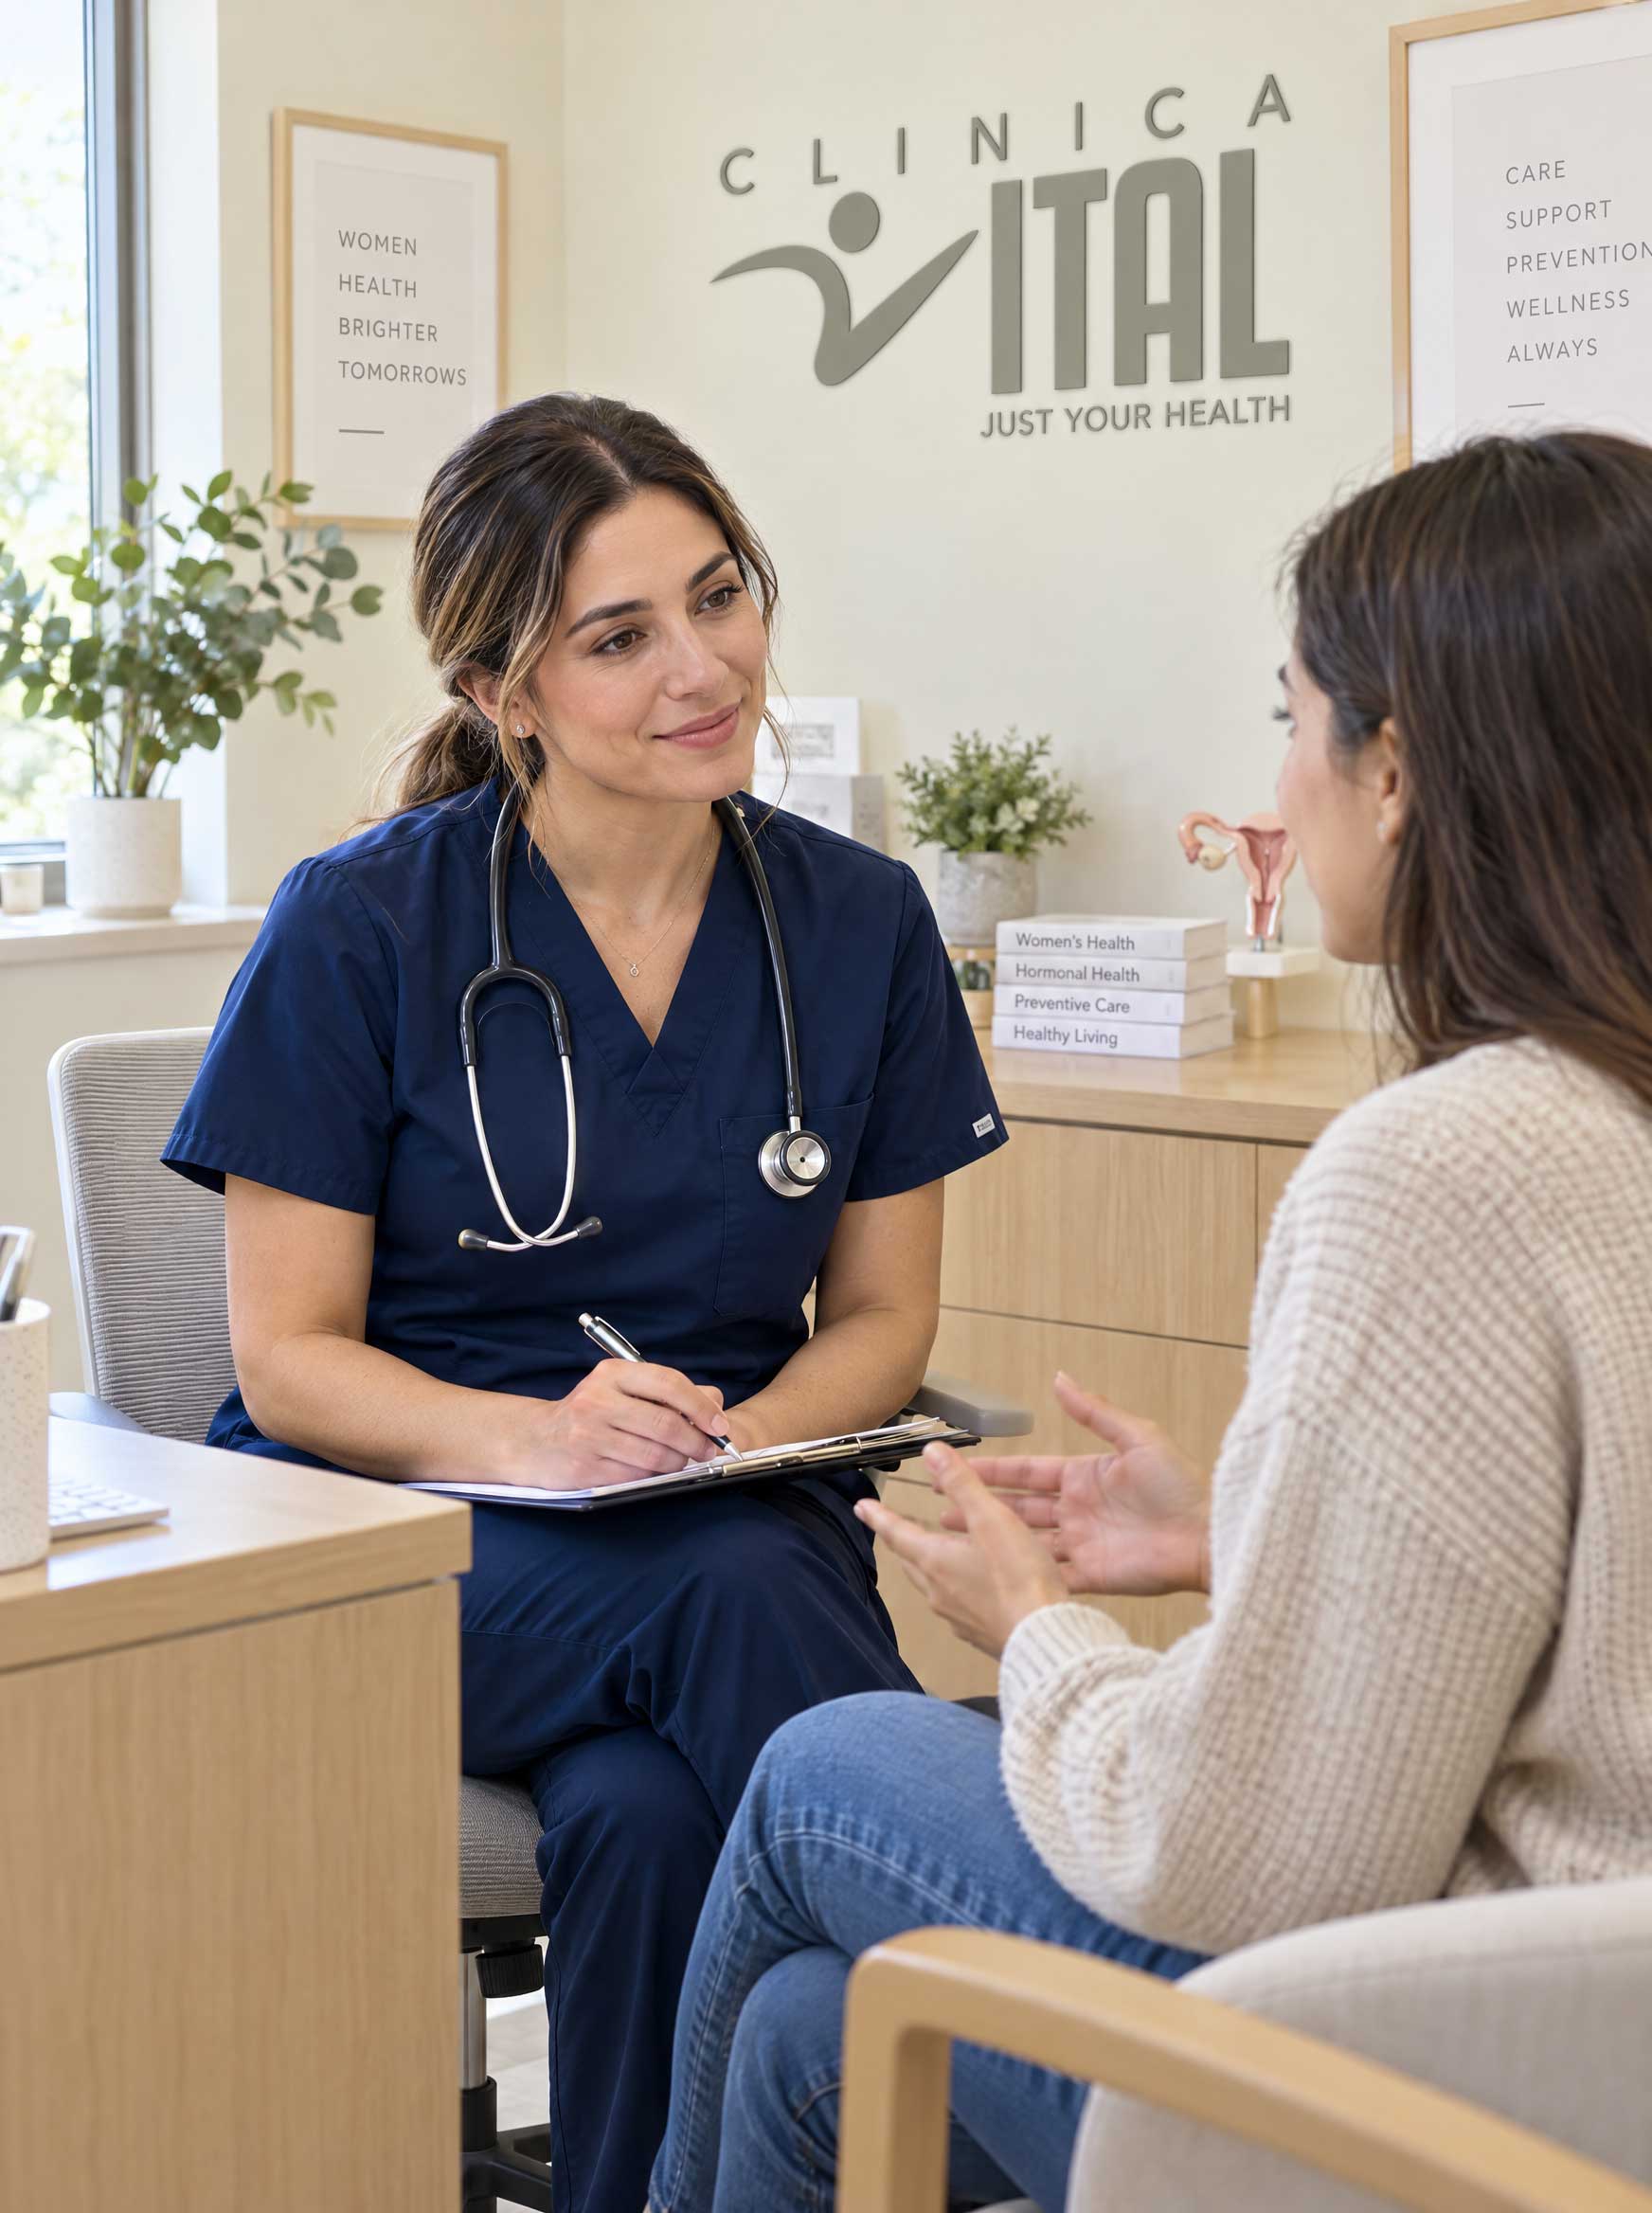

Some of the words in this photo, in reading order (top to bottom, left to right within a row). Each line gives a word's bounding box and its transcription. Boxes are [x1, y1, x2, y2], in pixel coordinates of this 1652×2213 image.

[720, 74, 1291, 195] CLINICA
[1506, 160, 1566, 184] CARE
[1506, 200, 1612, 229] SUPPORT
[338, 230, 417, 256] WOMEN
[339, 274, 417, 298] HEALTH
[1506, 289, 1630, 318] WELLNESS
[339, 317, 438, 342] BRIGHTER
[1507, 338, 1598, 363] ALWAYS
[338, 360, 467, 387] TOMORROWS
[980, 408, 1053, 438] JUST
[1064, 404, 1152, 432] YOUR
[1165, 394, 1291, 427] HEALTH
[1015, 932, 1083, 948] Women's
[1086, 934, 1136, 950] Health
[1015, 963, 1087, 980] Hormonal
[1091, 965, 1140, 982] Health
[1015, 994, 1090, 1013] Preventive
[1095, 998, 1130, 1013] Care
[1014, 1025, 1070, 1046] Healthy
[1074, 1030, 1118, 1049] Living
